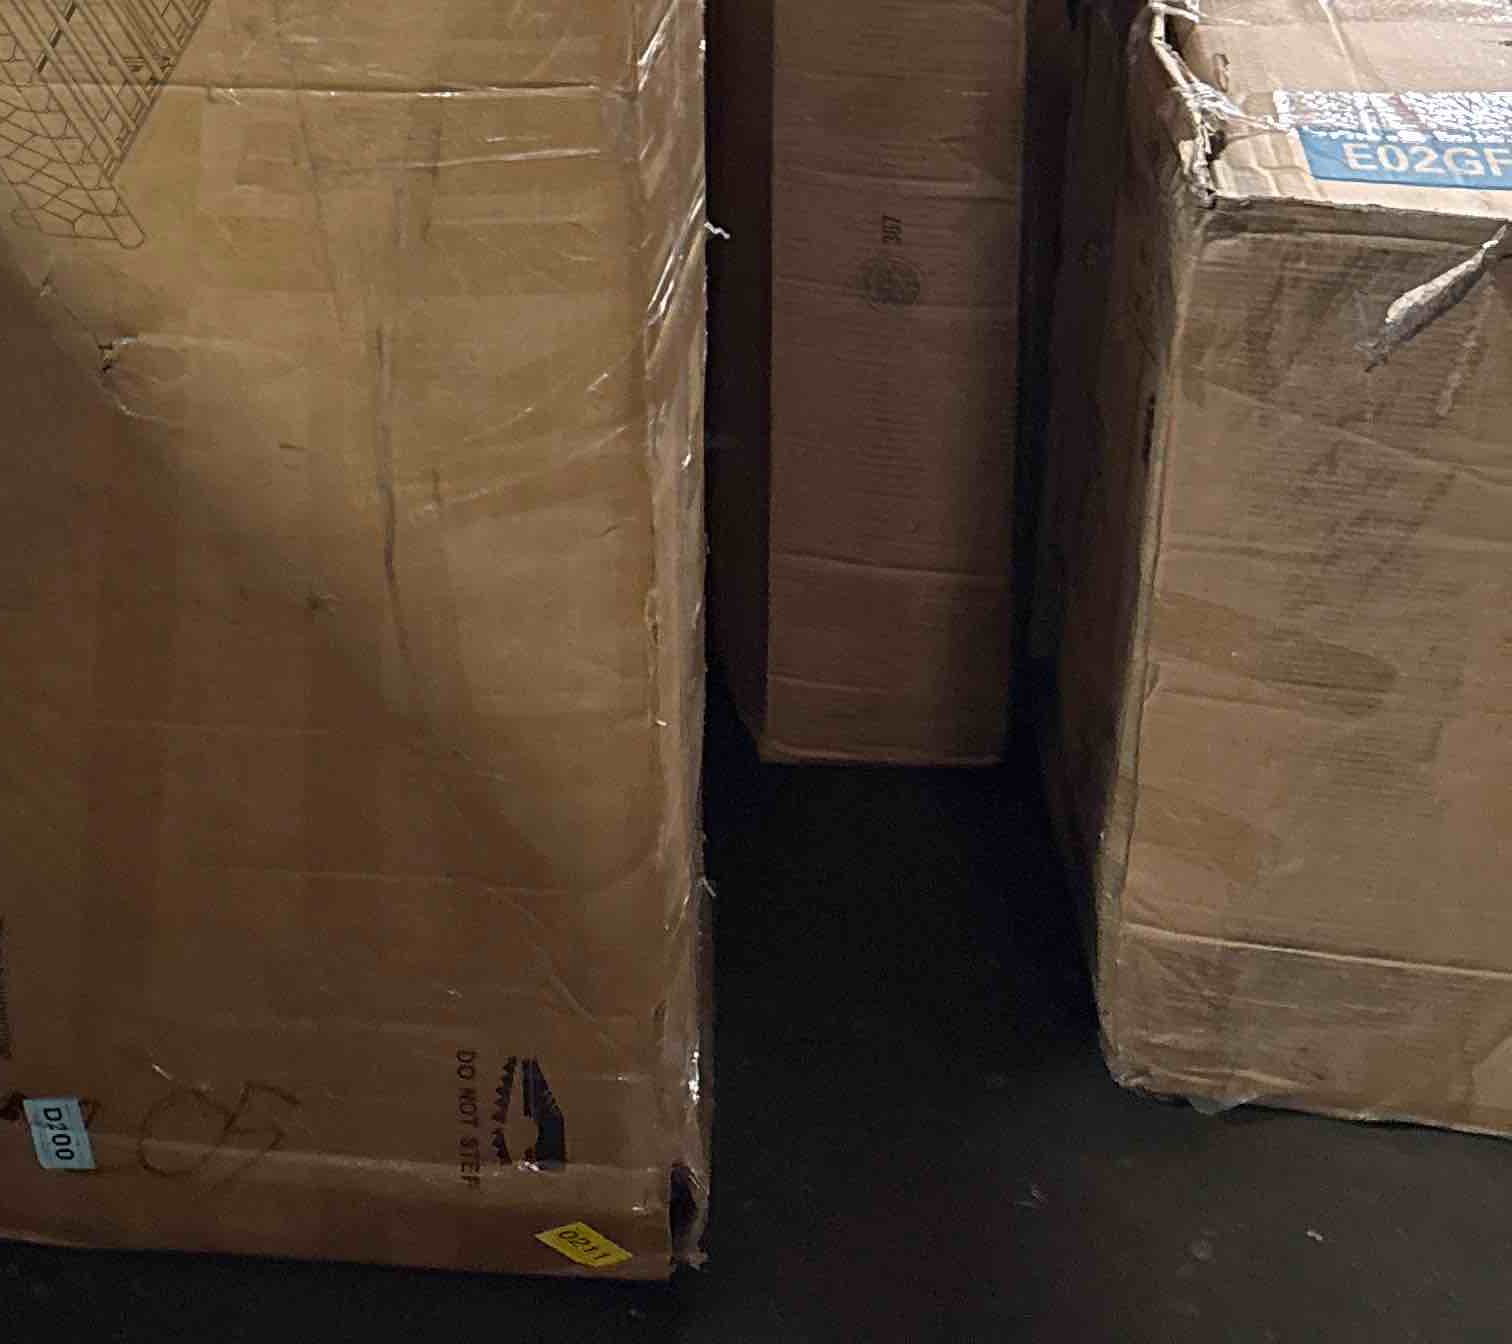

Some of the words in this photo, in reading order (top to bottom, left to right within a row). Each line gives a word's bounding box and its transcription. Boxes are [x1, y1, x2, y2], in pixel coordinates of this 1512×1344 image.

[456, 1049, 477, 1081] DO
[458, 1088, 480, 1128] NOT
[43, 1107, 75, 1161] D200
